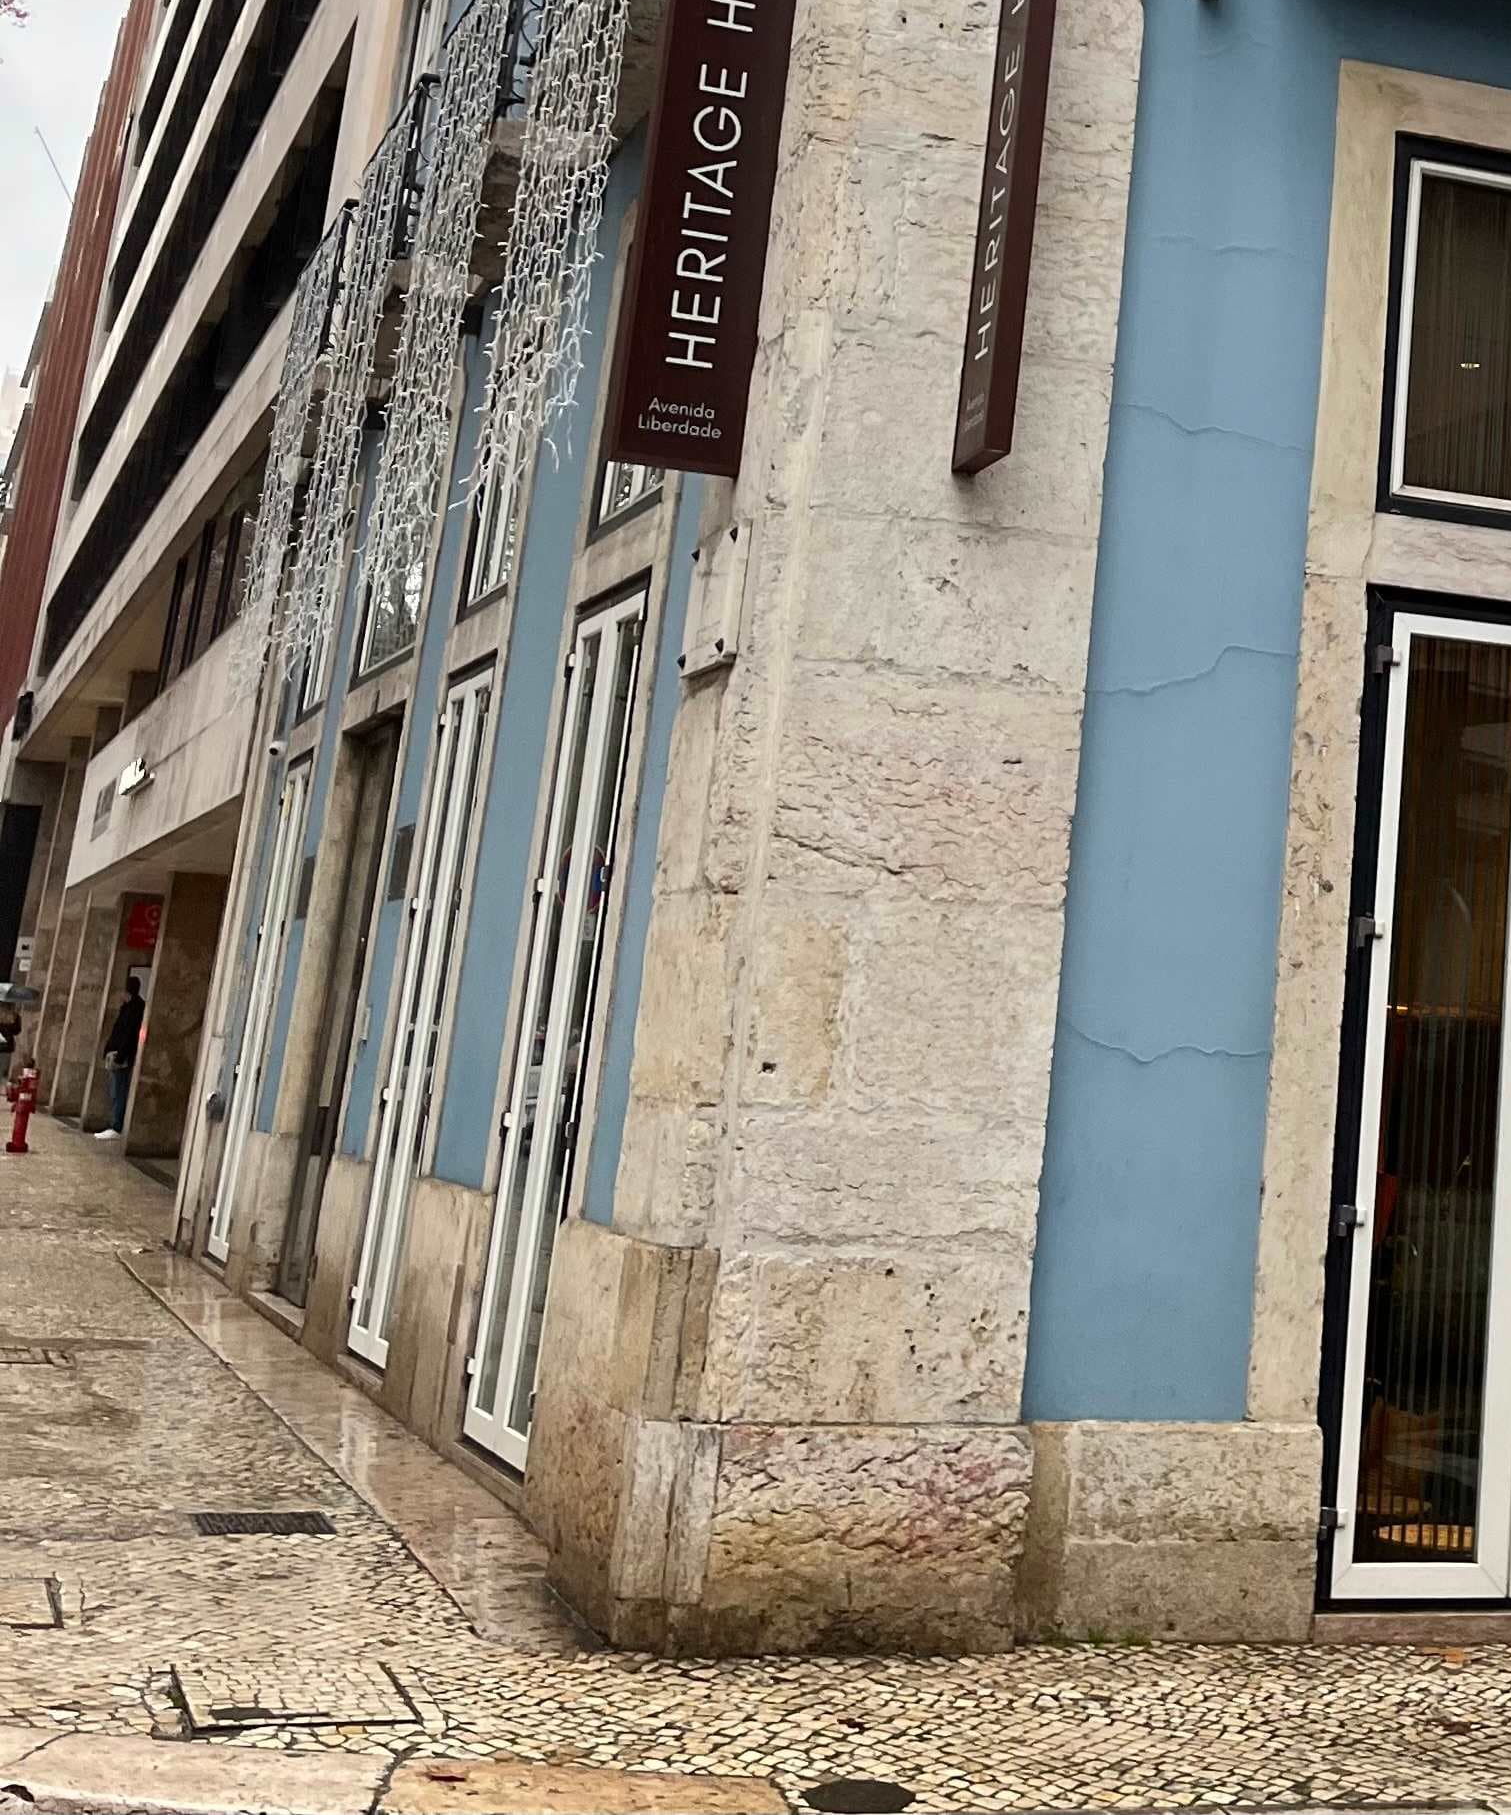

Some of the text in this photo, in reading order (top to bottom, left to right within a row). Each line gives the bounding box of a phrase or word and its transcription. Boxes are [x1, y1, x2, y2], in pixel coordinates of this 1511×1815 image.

[665, 63, 748, 369] HERITAGE
[974, 43, 1021, 361] HERITAGE
[638, 413, 722, 439] Liberdade
[648, 397, 715, 419] Avenida
